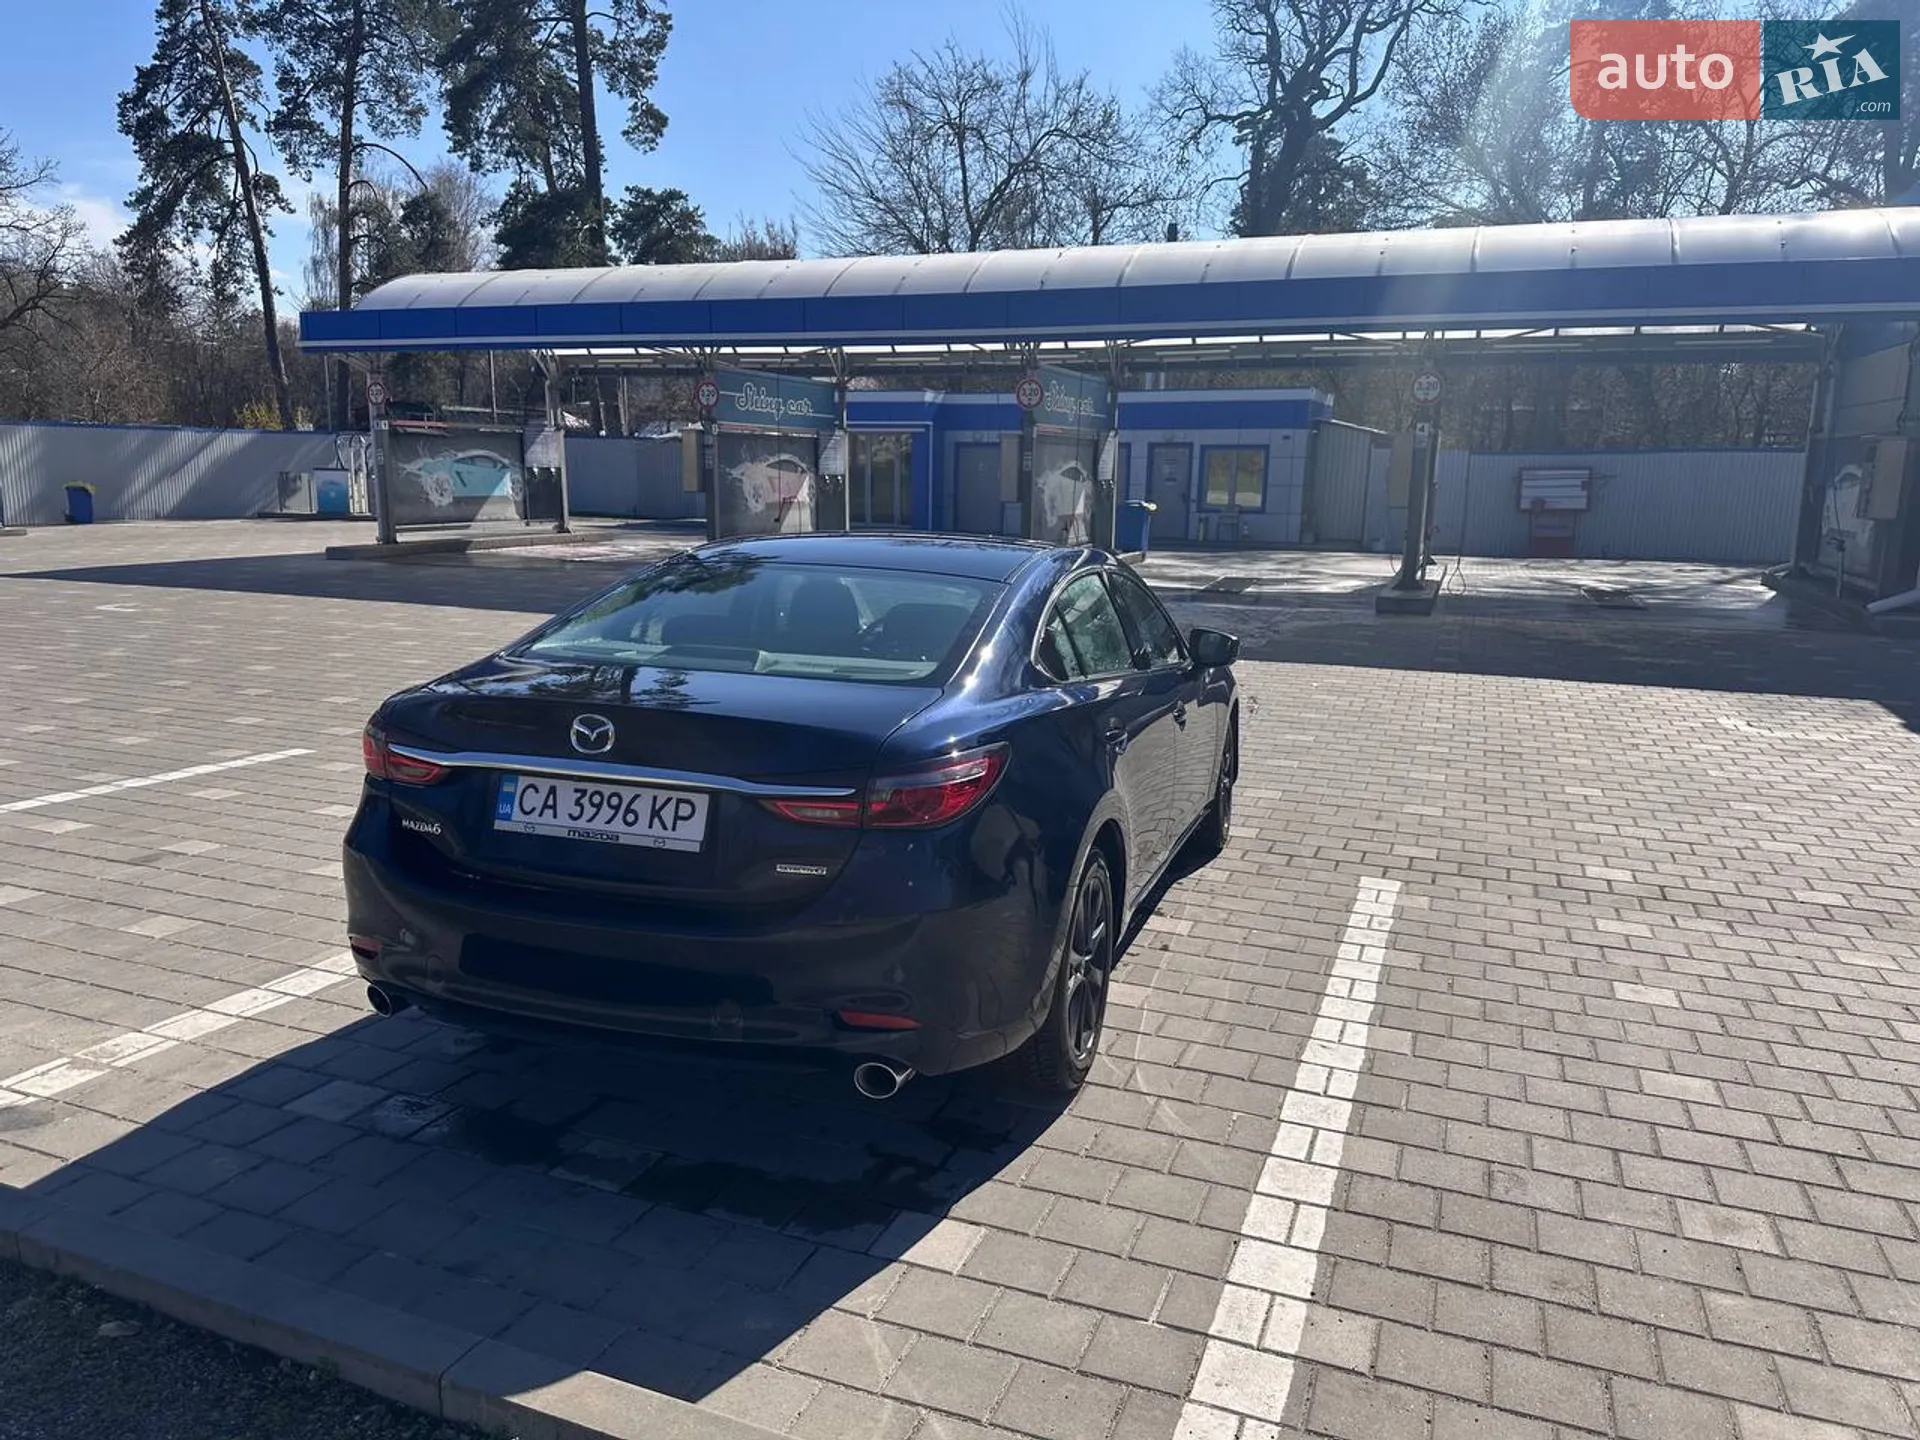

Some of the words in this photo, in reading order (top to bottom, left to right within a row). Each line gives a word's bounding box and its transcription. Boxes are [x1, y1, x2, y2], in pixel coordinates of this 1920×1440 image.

[735, 382, 785, 421] Shiny
[786, 397, 815, 416] car
[498, 804, 512, 815] UA
[518, 783, 558, 820] CA
[567, 787, 642, 828] 3996
[648, 794, 697, 832] KP
[402, 819, 442, 836] MAZDA6
[567, 829, 620, 842] mazda
